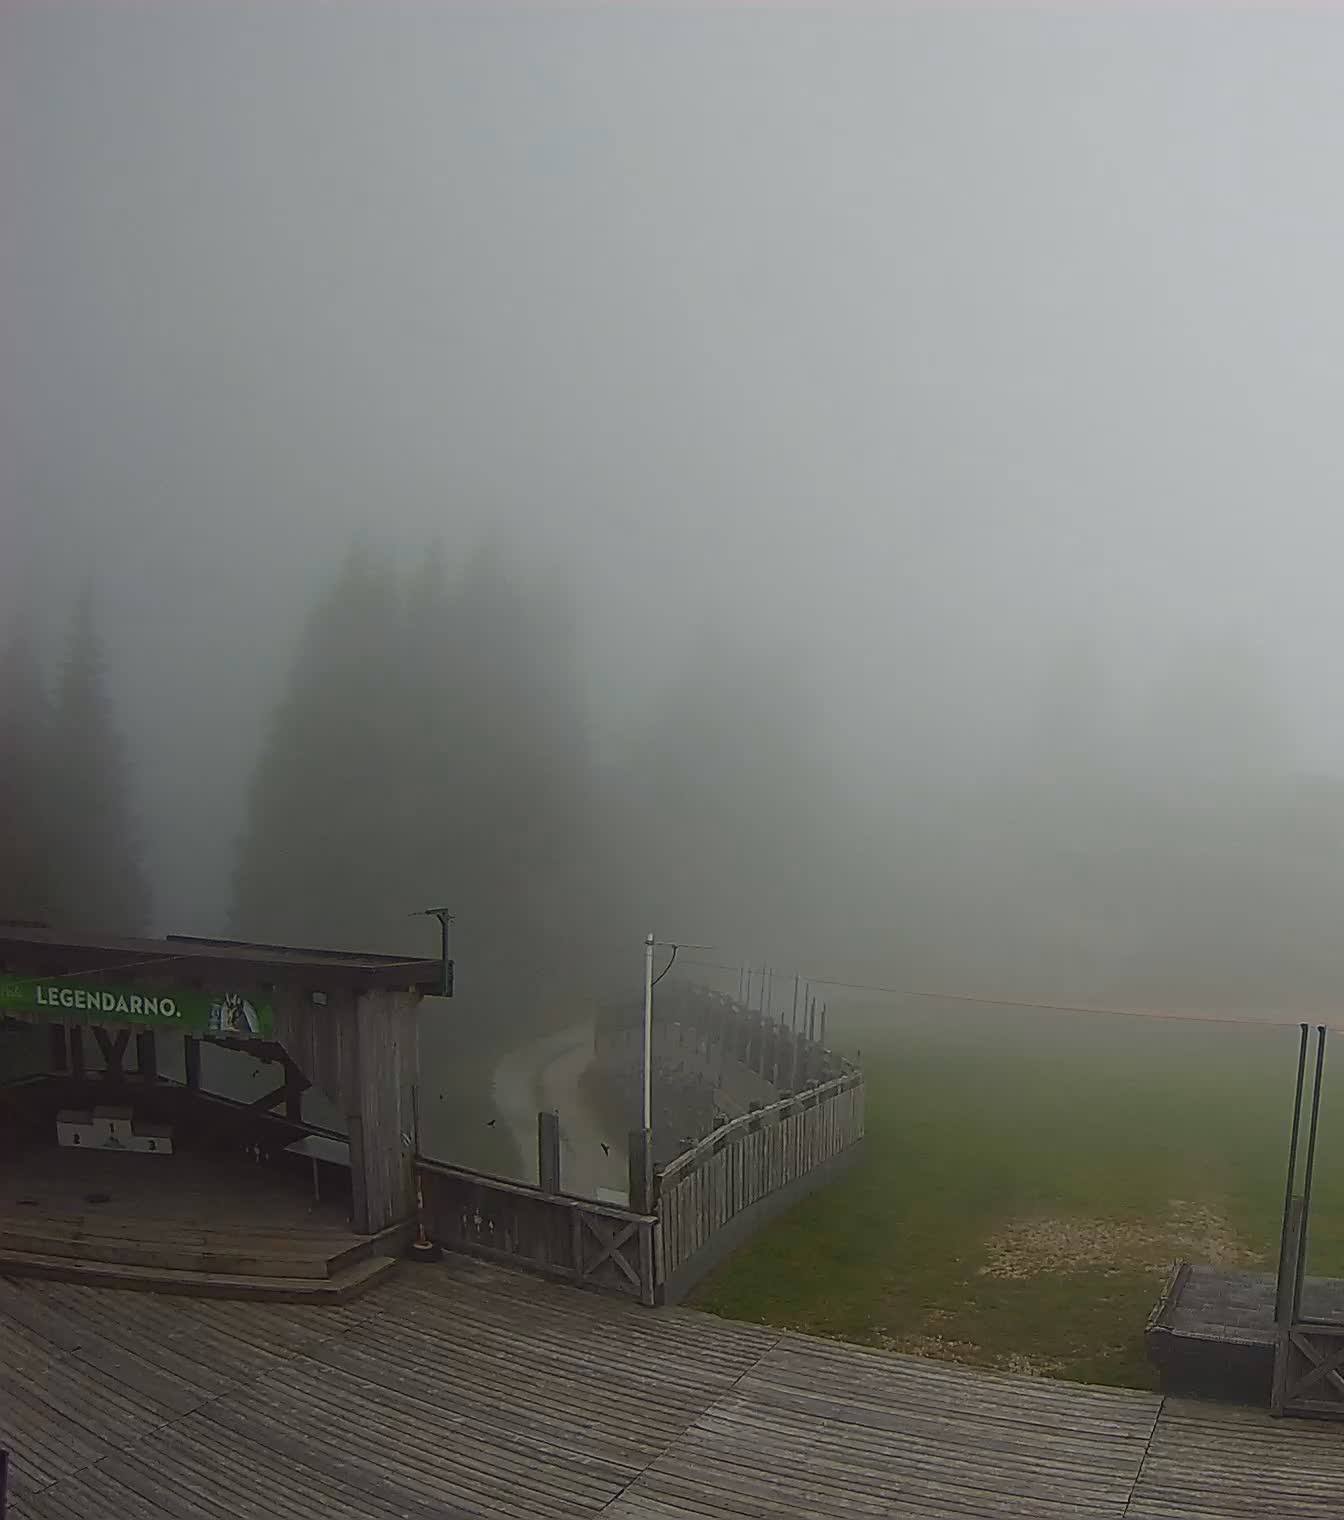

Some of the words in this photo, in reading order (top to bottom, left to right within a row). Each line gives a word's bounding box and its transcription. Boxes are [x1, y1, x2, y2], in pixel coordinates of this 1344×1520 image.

[36, 985, 182, 1018] LEGENDARNO.
[73, 1133, 81, 1145] 2
[147, 1139, 157, 1151] 3
